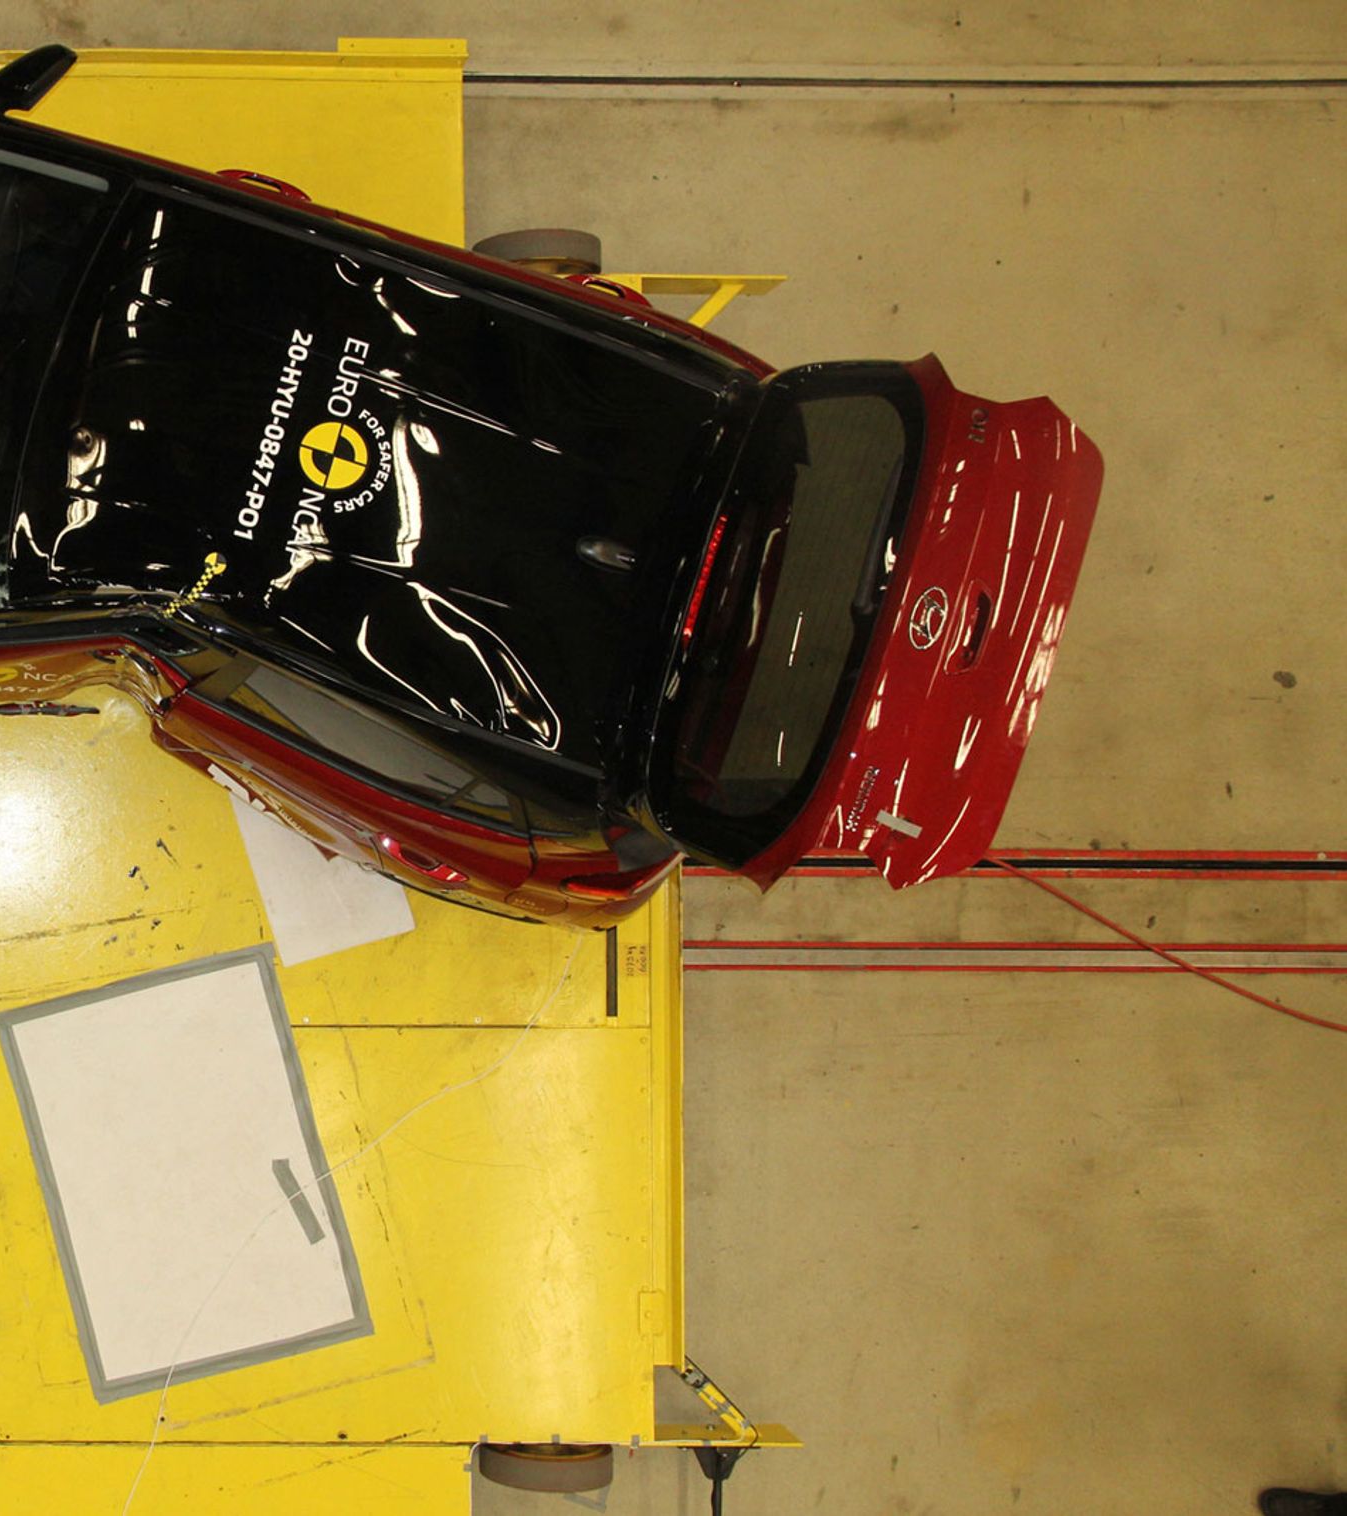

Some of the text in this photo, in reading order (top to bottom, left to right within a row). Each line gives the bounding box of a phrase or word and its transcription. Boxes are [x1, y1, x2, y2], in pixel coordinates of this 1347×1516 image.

[285, 336, 370, 569] EURO NCAP
[333, 408, 392, 513] FOR SAFER CARS
